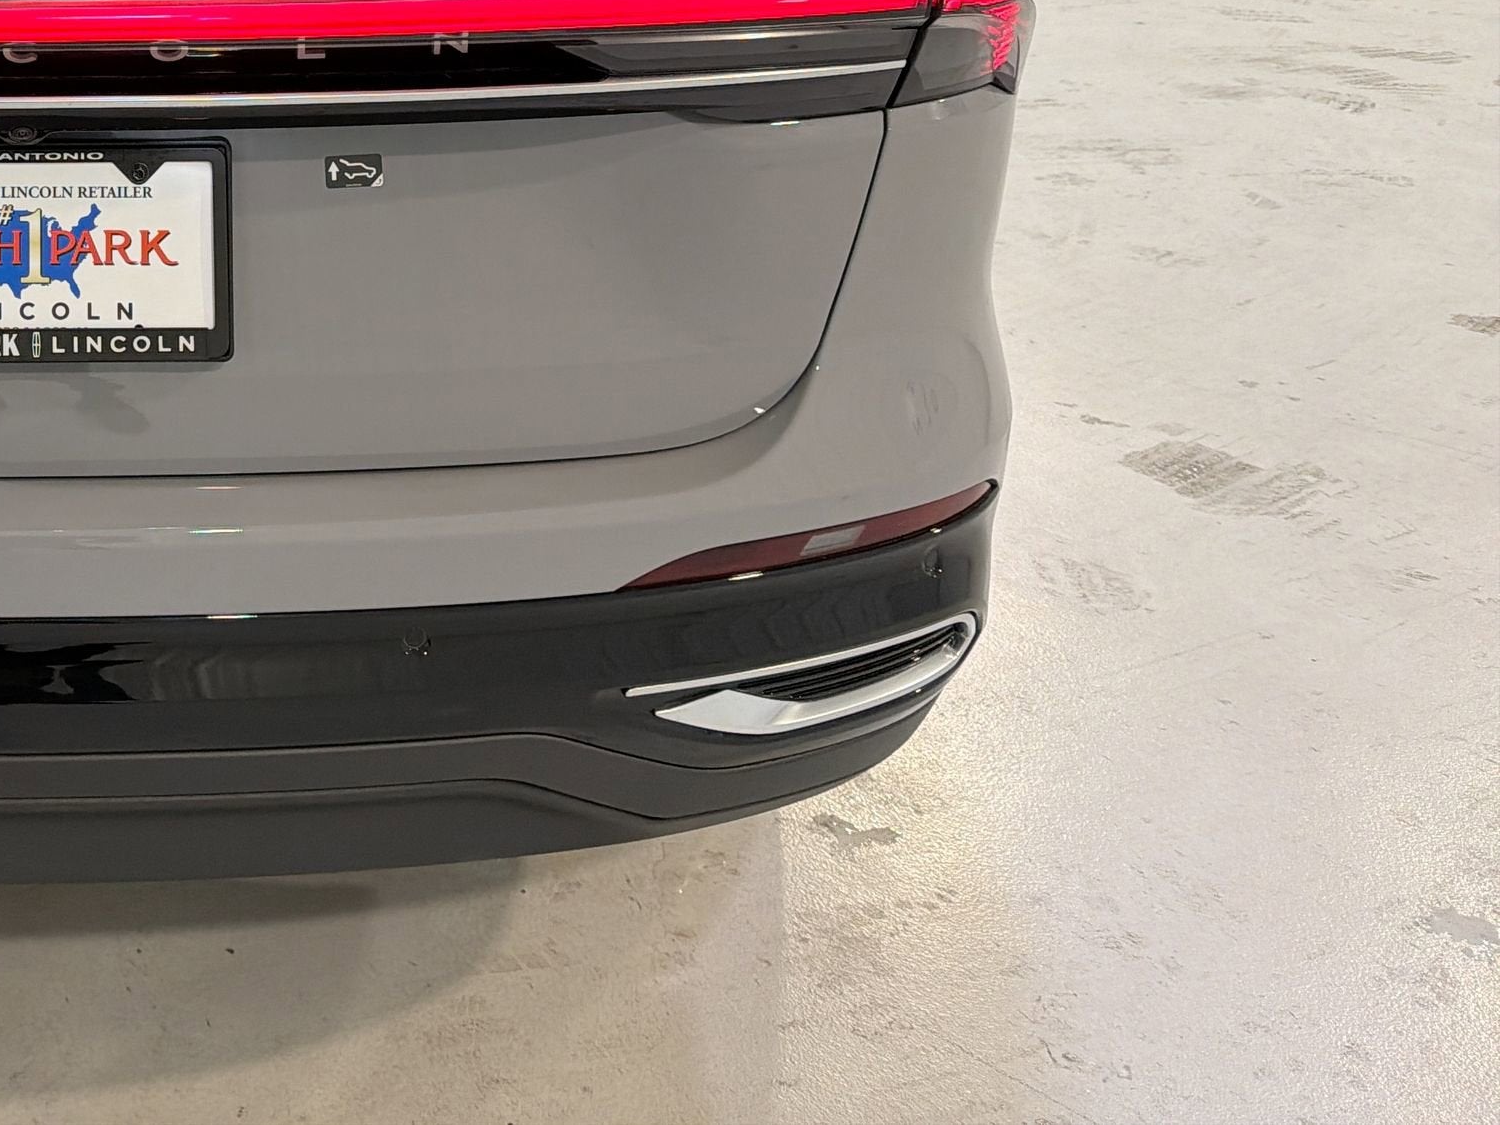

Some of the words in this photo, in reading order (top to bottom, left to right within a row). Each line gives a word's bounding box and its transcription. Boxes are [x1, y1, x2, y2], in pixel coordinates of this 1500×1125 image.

[0, 152, 104, 161] ANTONIO
[0, 186, 74, 199] LINCOLN
[78, 186, 152, 199] RETAILER
[49, 229, 179, 267] PARK
[52, 335, 195, 353] LINCOLN
